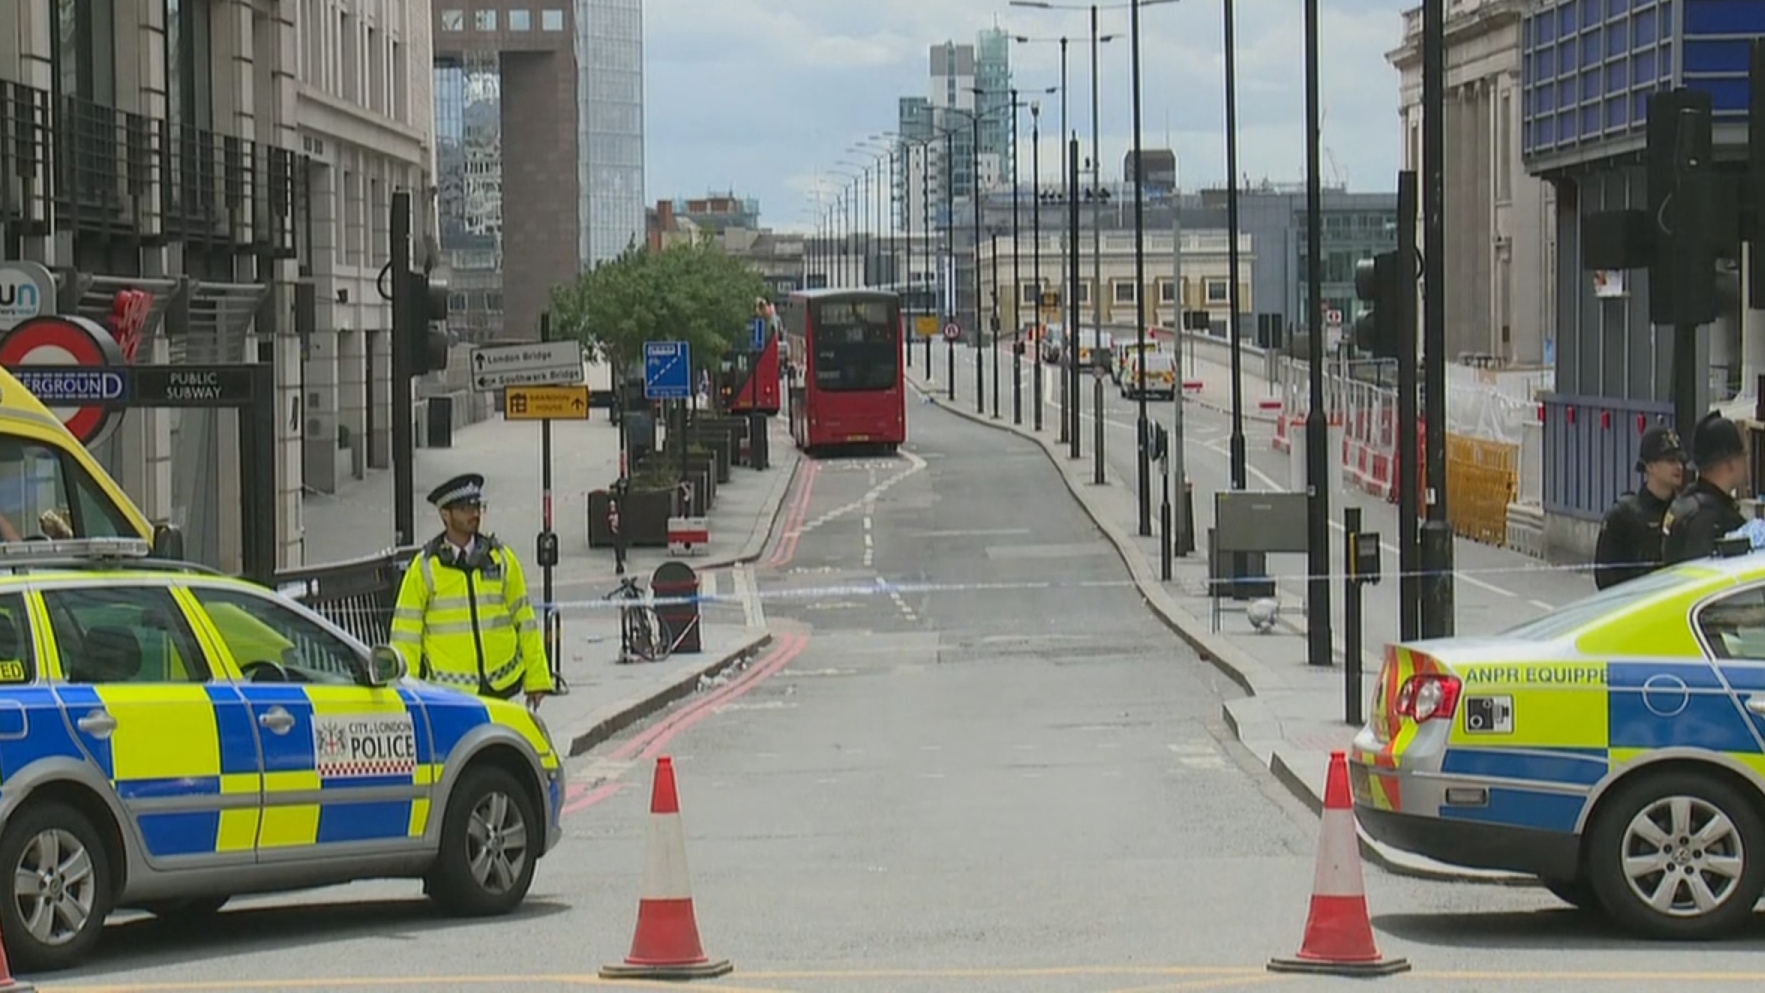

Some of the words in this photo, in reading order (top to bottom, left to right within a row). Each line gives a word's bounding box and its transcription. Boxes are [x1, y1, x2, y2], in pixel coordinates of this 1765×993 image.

[487, 354, 520, 364] London
[522, 351, 552, 361] Bridge
[170, 373, 217, 385] PUBLIC
[549, 370, 579, 381] Bridge
[166, 386, 222, 399] SUBWAY
[1466, 668, 1519, 683] ANPR
[1526, 668, 1624, 683] EQUIPPE
[349, 723, 368, 734] CITY
[373, 721, 412, 734] LONDON
[351, 735, 414, 760] POLICE
